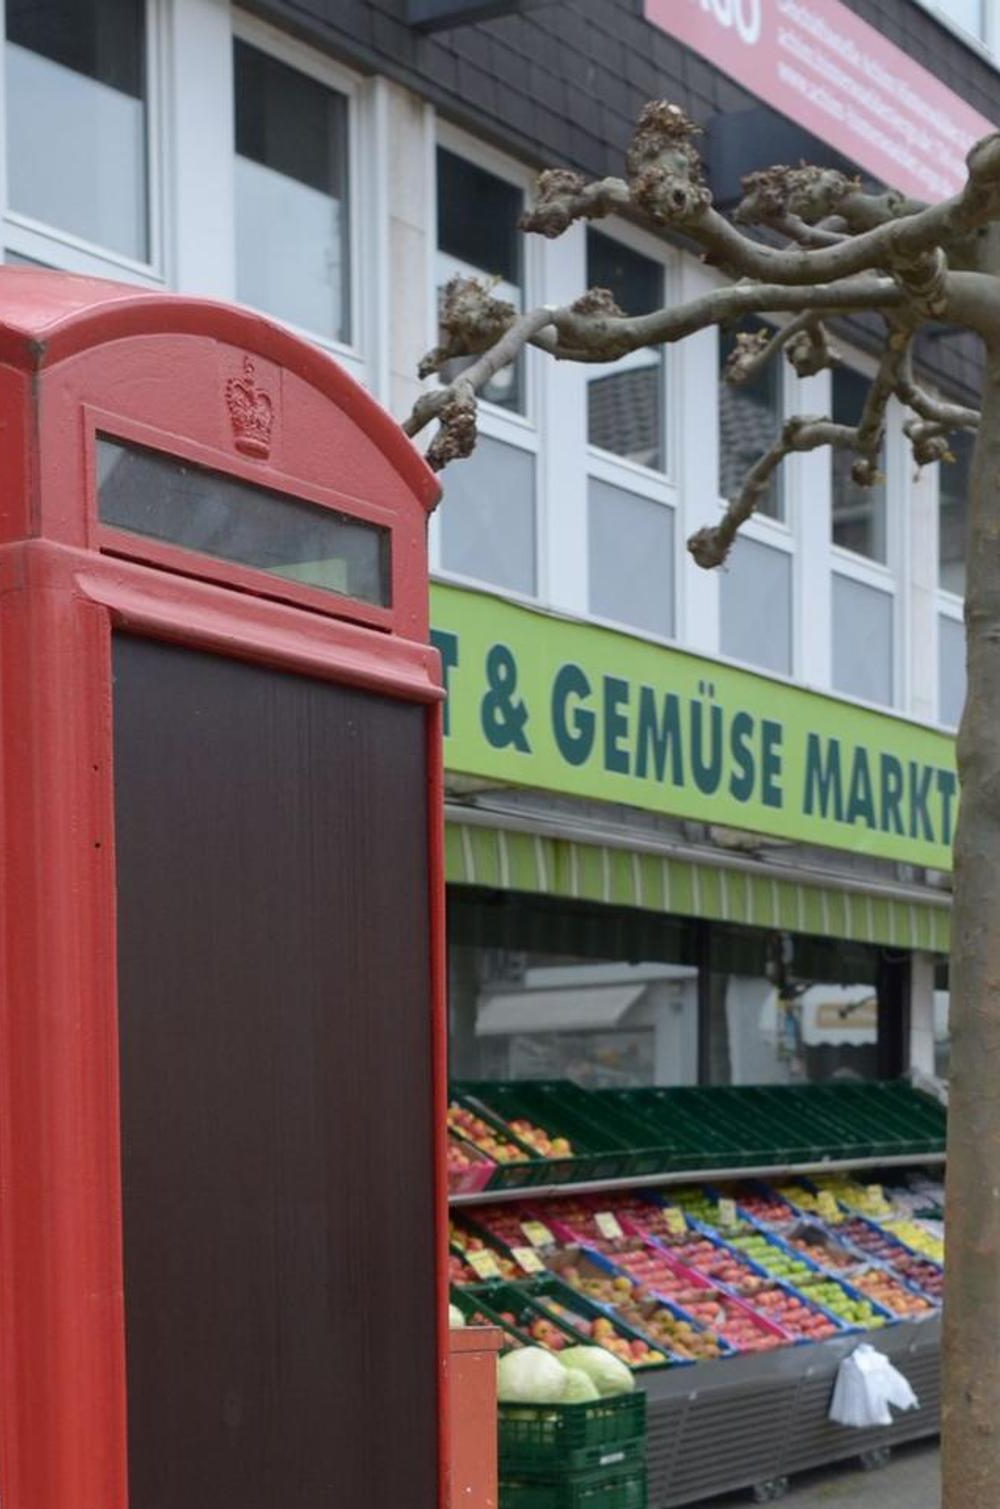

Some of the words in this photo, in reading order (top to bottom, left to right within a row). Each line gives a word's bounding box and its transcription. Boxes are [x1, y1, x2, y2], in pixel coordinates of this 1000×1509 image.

[481, 644, 532, 754] &
[551, 664, 783, 808] GEMÜSE
[803, 733, 956, 846] MARKT
